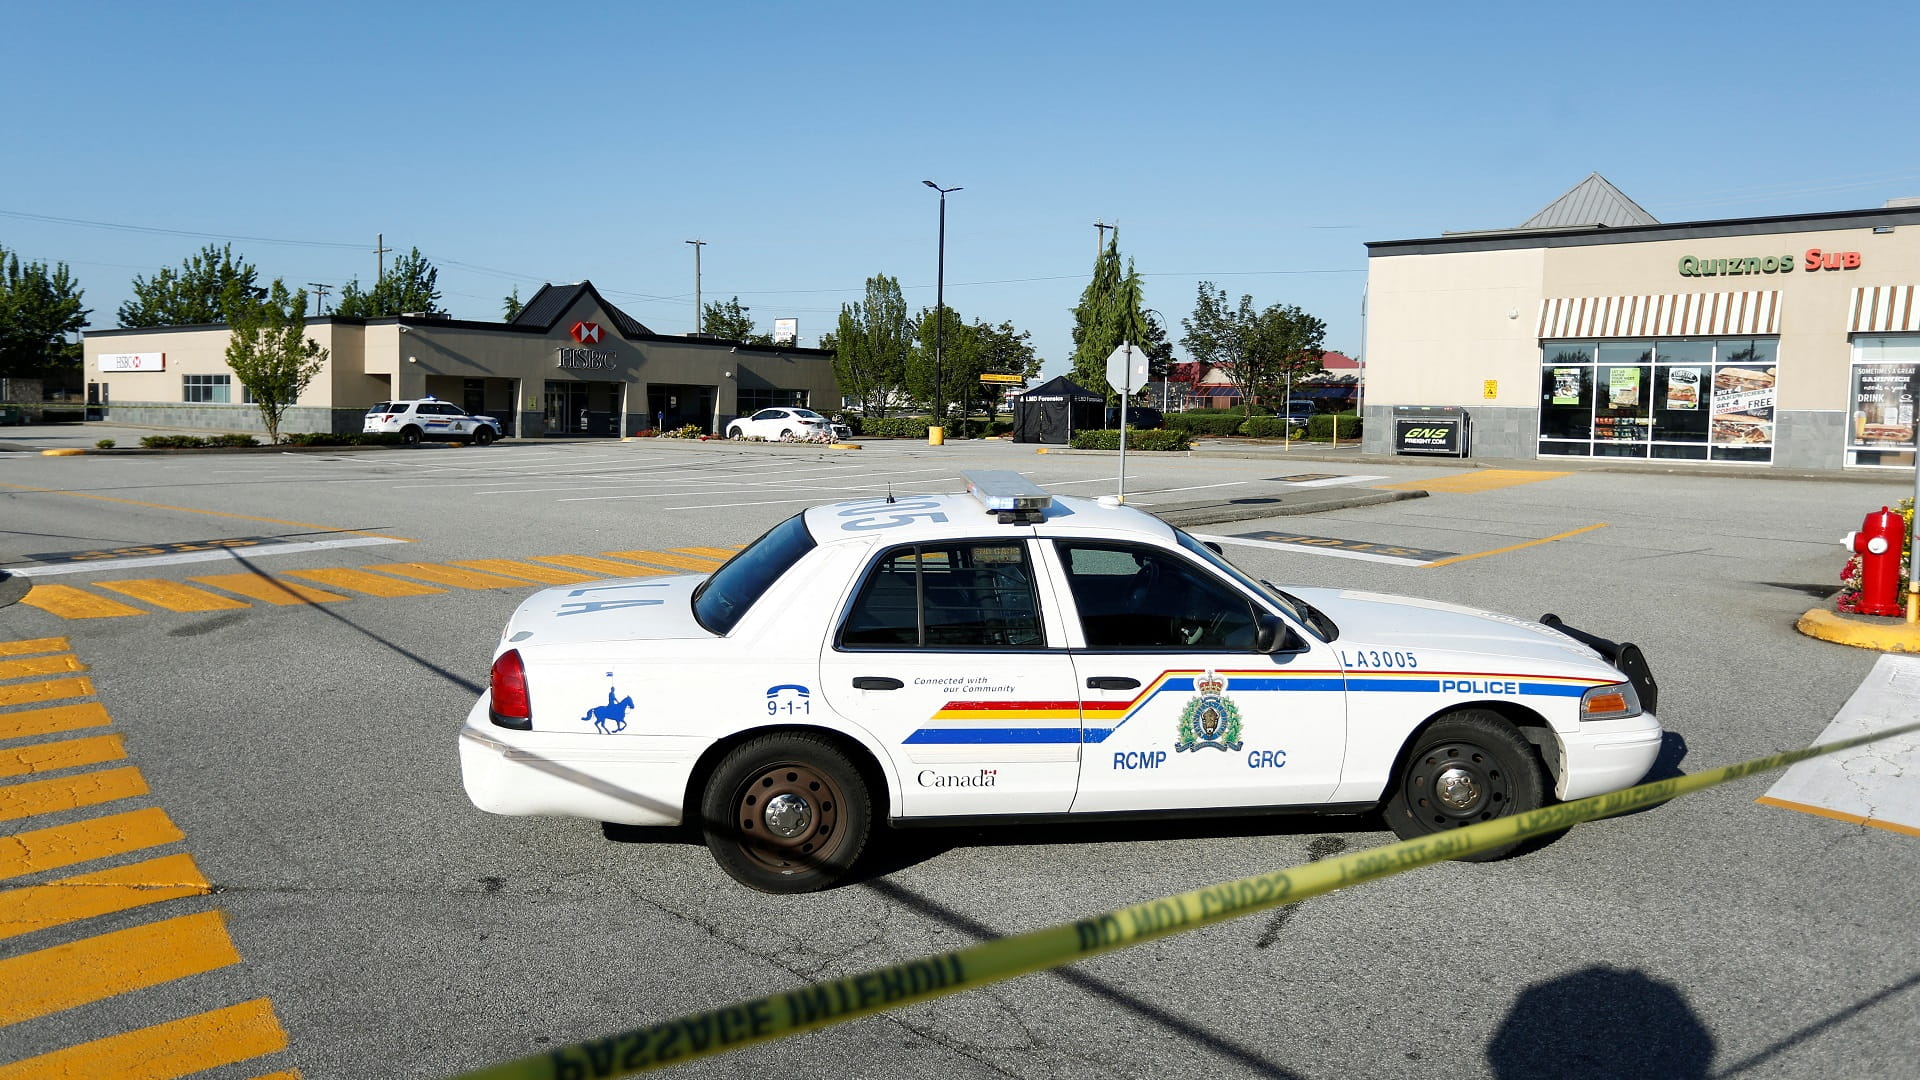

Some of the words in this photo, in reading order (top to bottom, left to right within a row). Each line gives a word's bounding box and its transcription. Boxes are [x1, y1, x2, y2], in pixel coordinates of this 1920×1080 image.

[1678, 255, 1794, 277] Quiznos
[116, 356, 132, 368] HSBC
[555, 347, 617, 371] HSBC
[1857, 367, 1892, 375] SOMETIMES
[1863, 383, 1883, 391] needs
[1891, 383, 1907, 393] good
[1716, 390, 1766, 402] SANDWICHES
[1748, 397, 1773, 408] FREE
[1857, 394, 1884, 402] DRINK
[1404, 428, 1450, 438] GNS
[556, 584, 670, 617] LA
[1341, 650, 1417, 668] LA3005
[914, 677, 964, 685] Connected
[967, 676, 988, 684] with
[962, 685, 1016, 694] Community
[1442, 680, 1516, 695] POLICE
[767, 700, 810, 716] 9-1-1
[1113, 751, 1167, 770] RCMP
[1247, 750, 1287, 768] GRC
[917, 769, 996, 788] Canada
